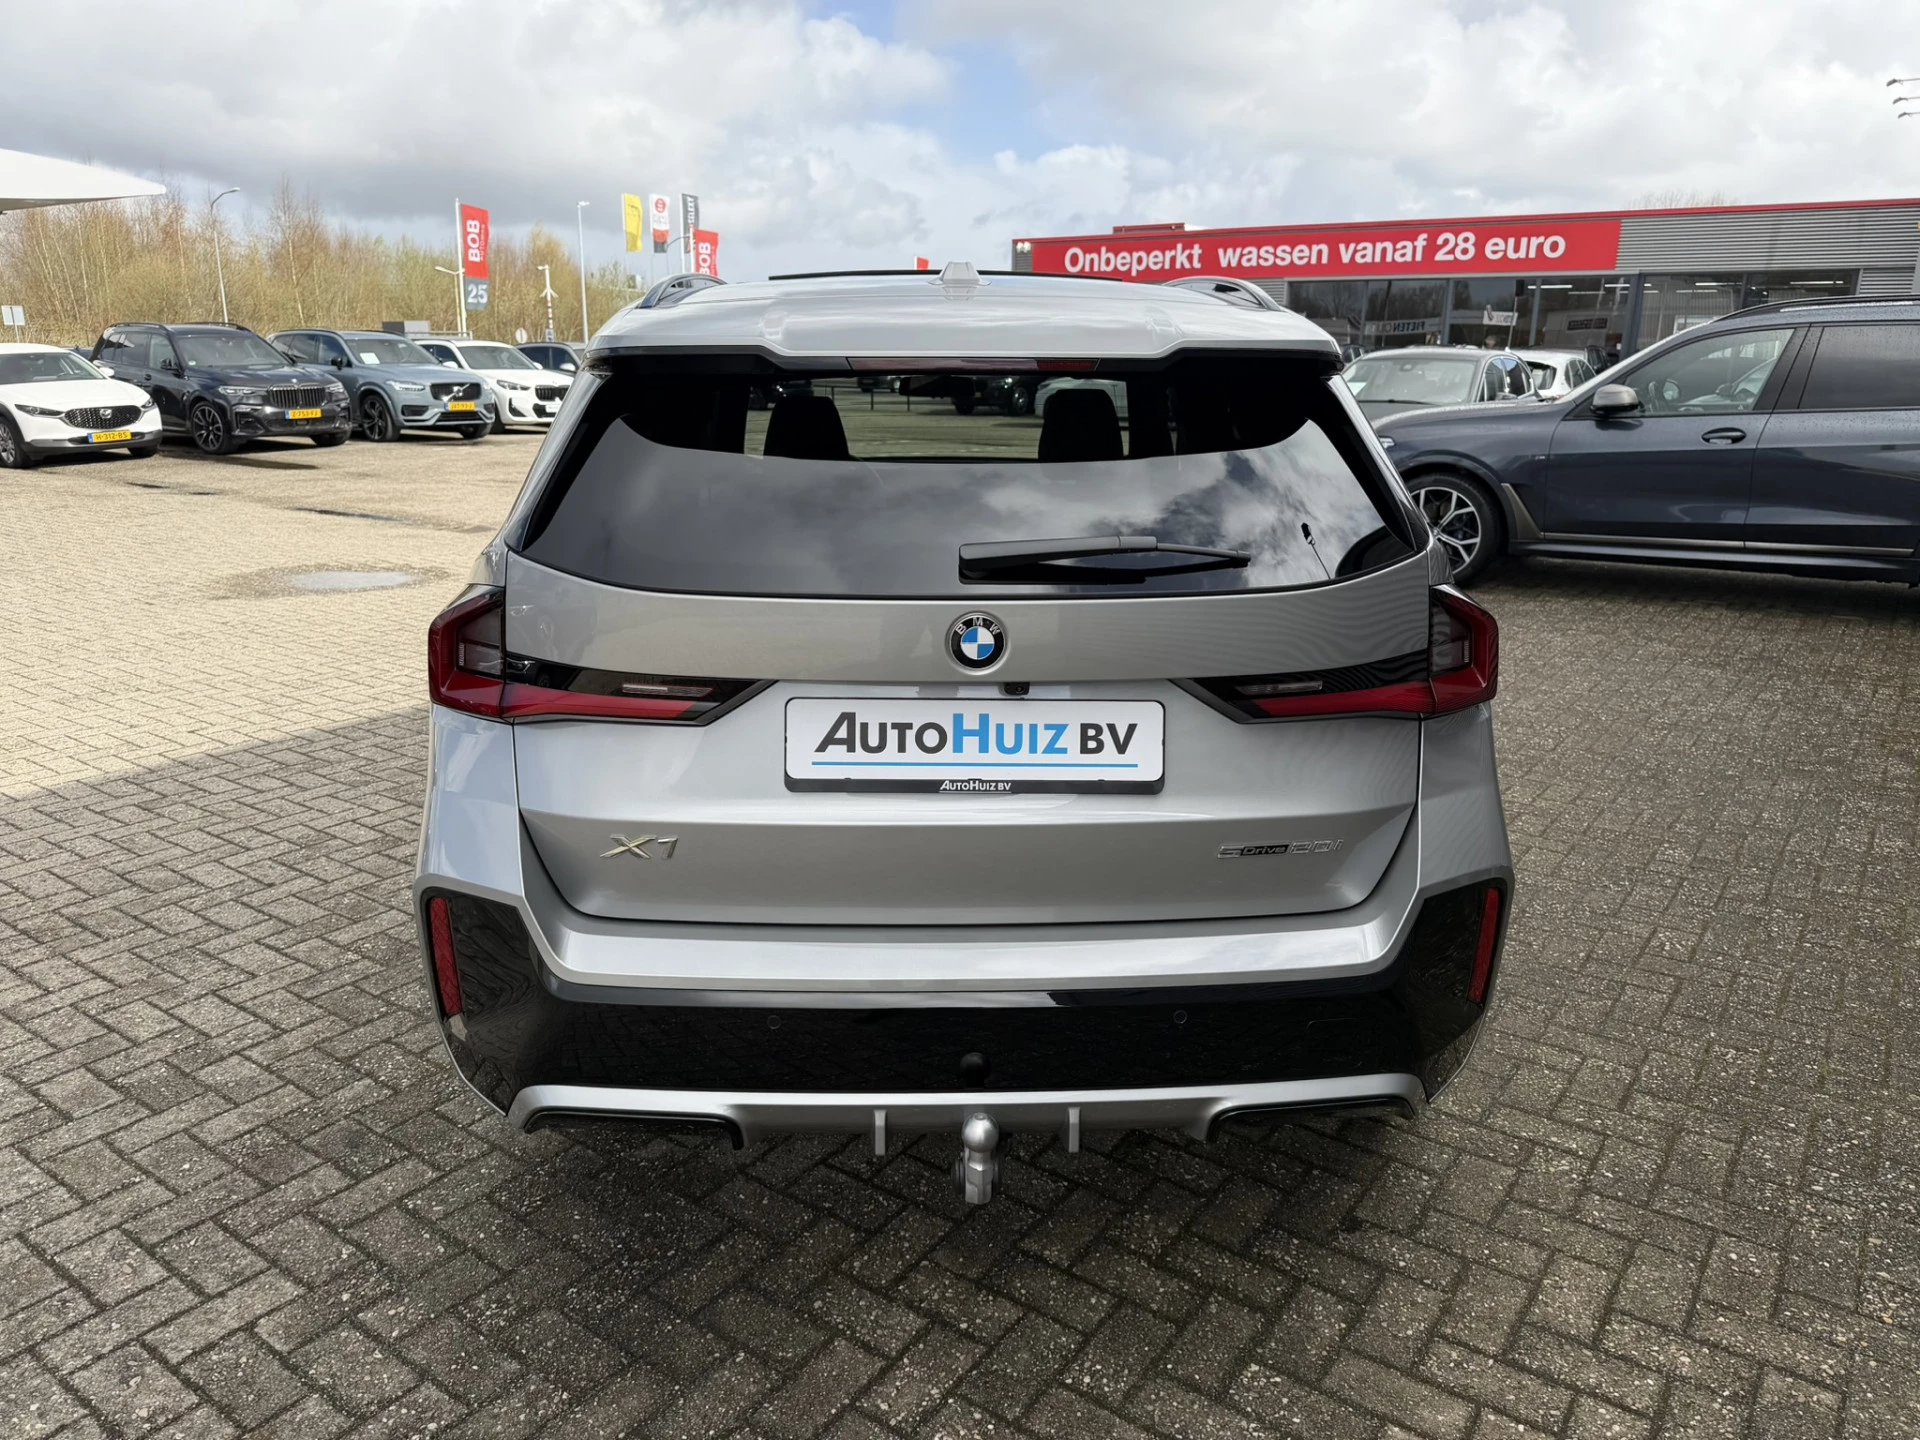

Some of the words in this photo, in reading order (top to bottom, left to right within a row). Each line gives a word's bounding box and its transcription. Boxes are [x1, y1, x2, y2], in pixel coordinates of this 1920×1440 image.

[466, 218, 481, 263] BOB
[1064, 242, 1202, 277] Onbeperkt
[1218, 242, 1329, 268] wassen
[1339, 233, 1428, 264] vanaf
[1434, 231, 1476, 262] 28
[1485, 234, 1566, 260] euro
[467, 284, 488, 304] 25
[955, 616, 1001, 635] BMW
[1079, 722, 1138, 755] BV
[997, 782, 1012, 791] BV
